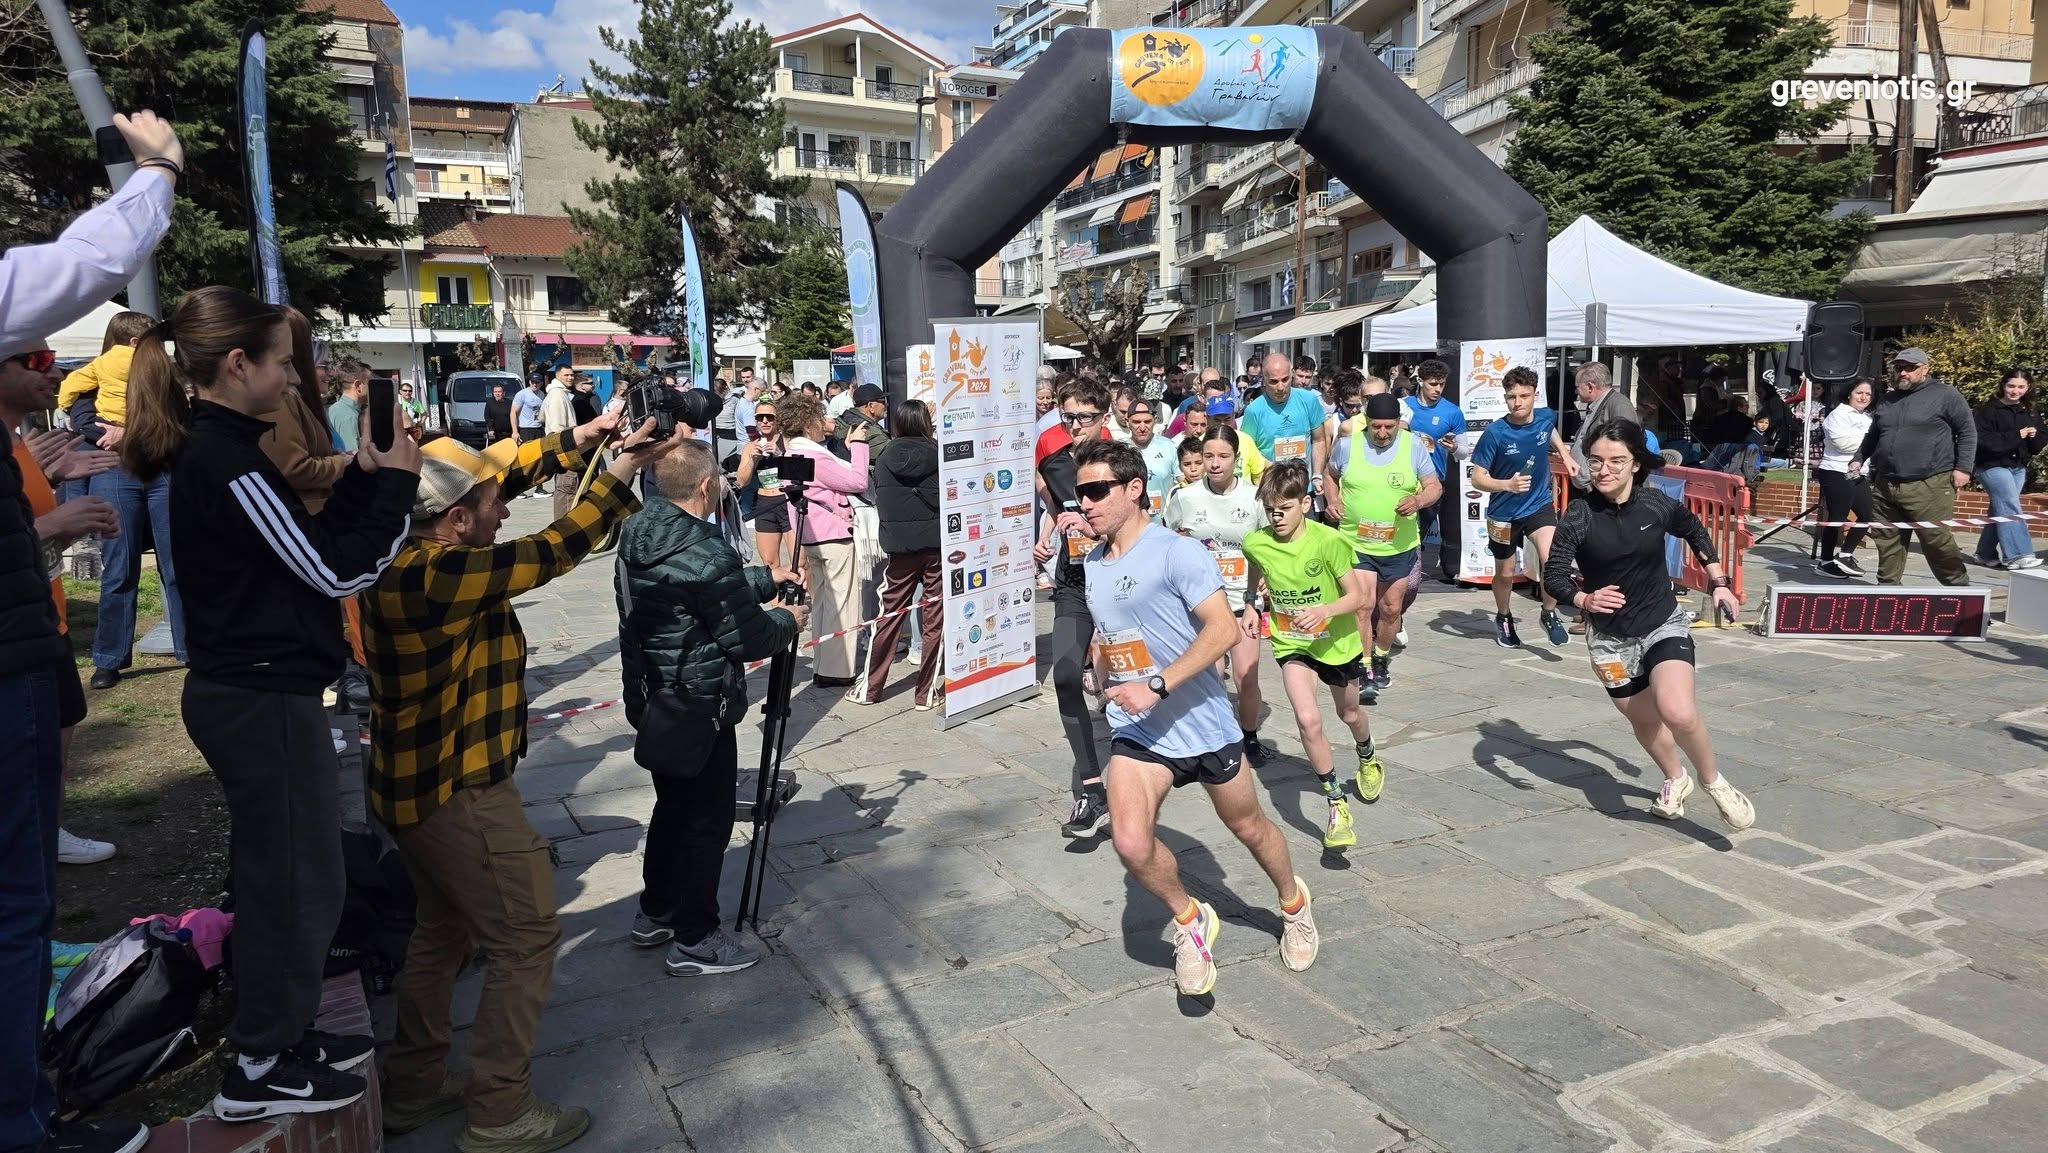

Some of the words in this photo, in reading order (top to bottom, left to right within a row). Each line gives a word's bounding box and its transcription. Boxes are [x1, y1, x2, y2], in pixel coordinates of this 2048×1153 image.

[943, 82, 986, 95] TOPOGEC
[942, 362, 967, 384] GREVENA
[970, 381, 988, 391] 2026
[1282, 446, 1298, 455] 587
[1367, 530, 1385, 538] 536
[1269, 589, 1298, 597] RACE
[1271, 594, 1321, 605] FACTORY
[1778, 596, 1962, 633] 00:00:02
[1110, 653, 1135, 670] 531
